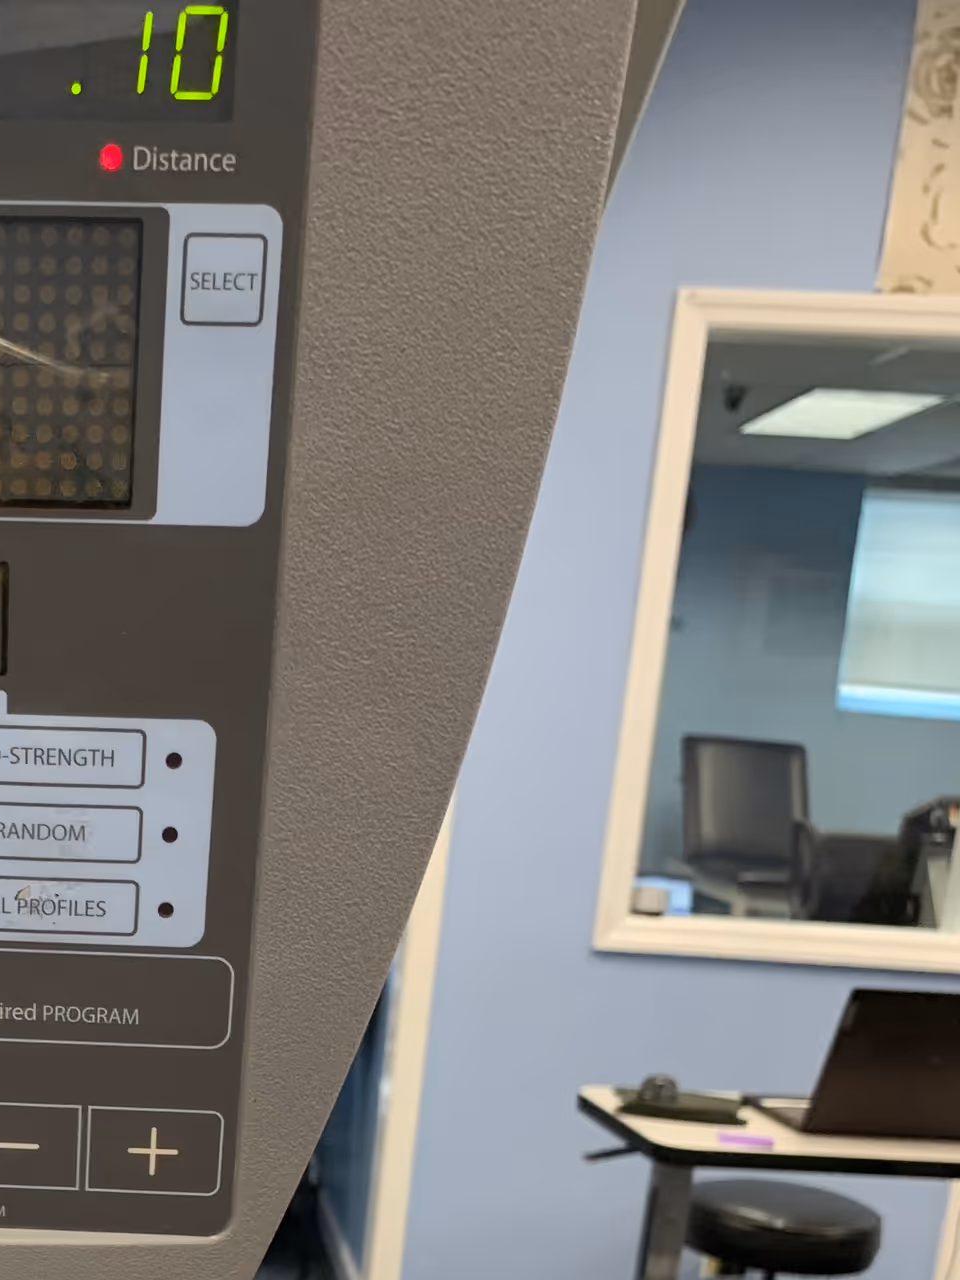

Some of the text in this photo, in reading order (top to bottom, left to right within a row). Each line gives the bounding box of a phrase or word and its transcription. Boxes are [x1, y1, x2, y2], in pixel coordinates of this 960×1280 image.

[132, 145, 237, 172] Distance
[190, 272, 259, 292] SELECT
[16, 898, 107, 918] PROFILES
[42, 1005, 140, 1025] PROGRAM
